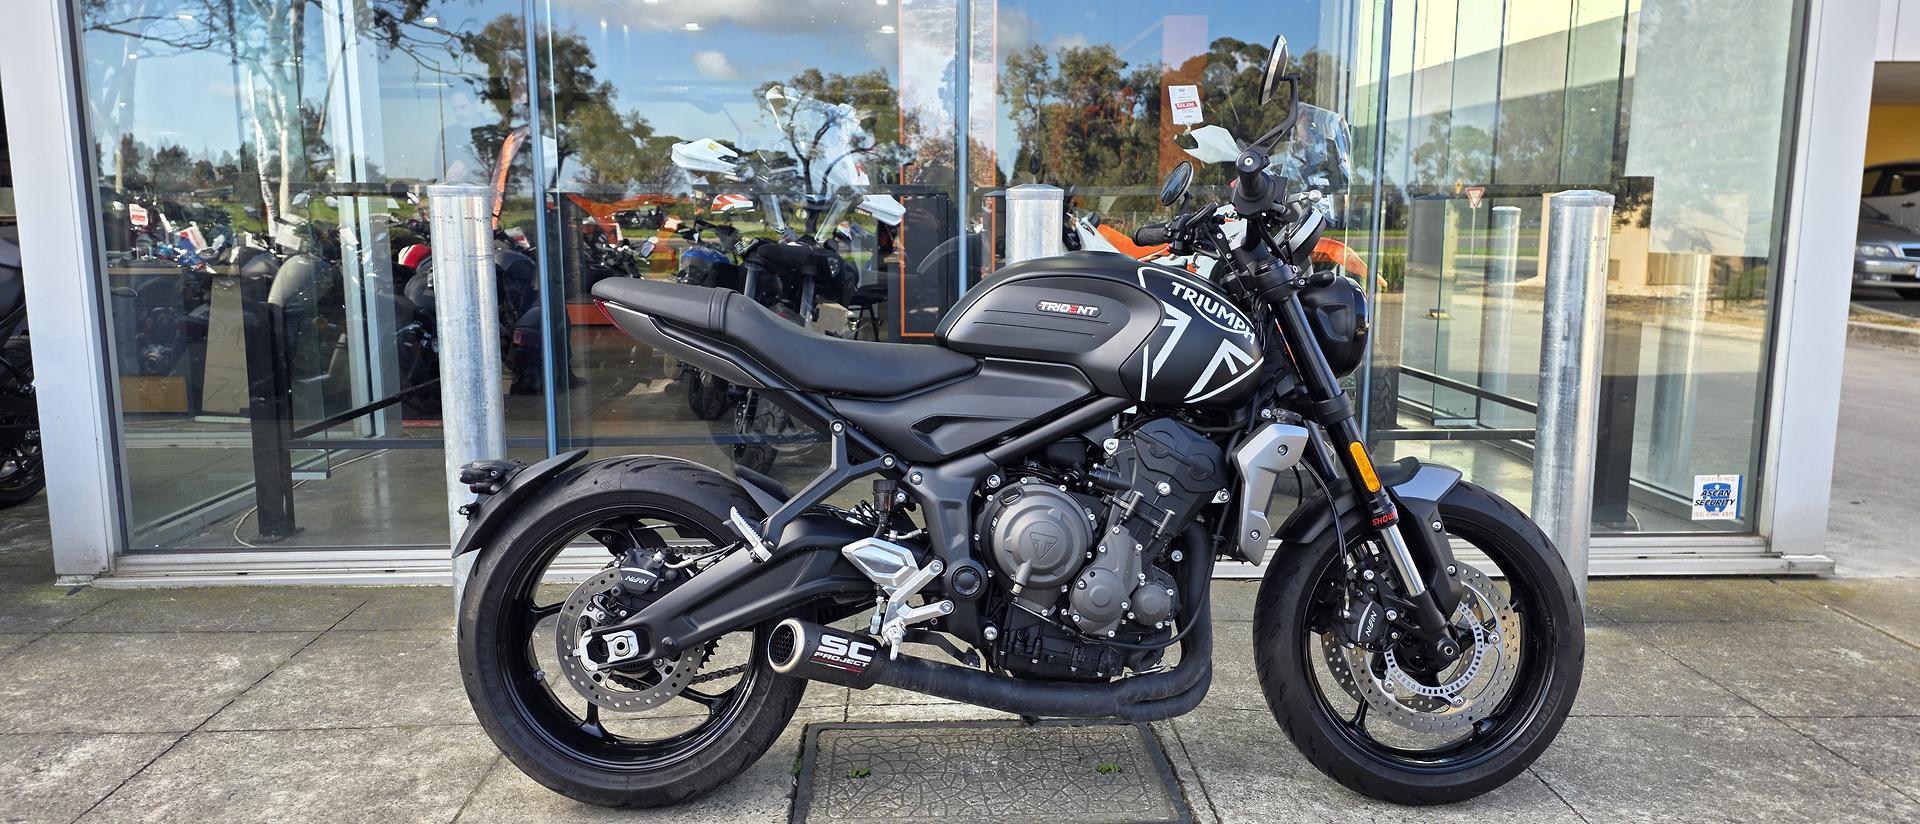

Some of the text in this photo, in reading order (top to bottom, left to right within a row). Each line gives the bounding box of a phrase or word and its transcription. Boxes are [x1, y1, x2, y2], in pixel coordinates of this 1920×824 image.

[1039, 301, 1098, 316] TRIDENT
[1171, 281, 1255, 345] TRIUMPH
[1700, 489, 1731, 497] ASCAN
[1694, 498, 1736, 506] SECURITY
[625, 575, 650, 585] NISSIN
[1365, 610, 1378, 637] NISSIN
[817, 634, 875, 662] SC
[813, 651, 869, 668] PROJECT
